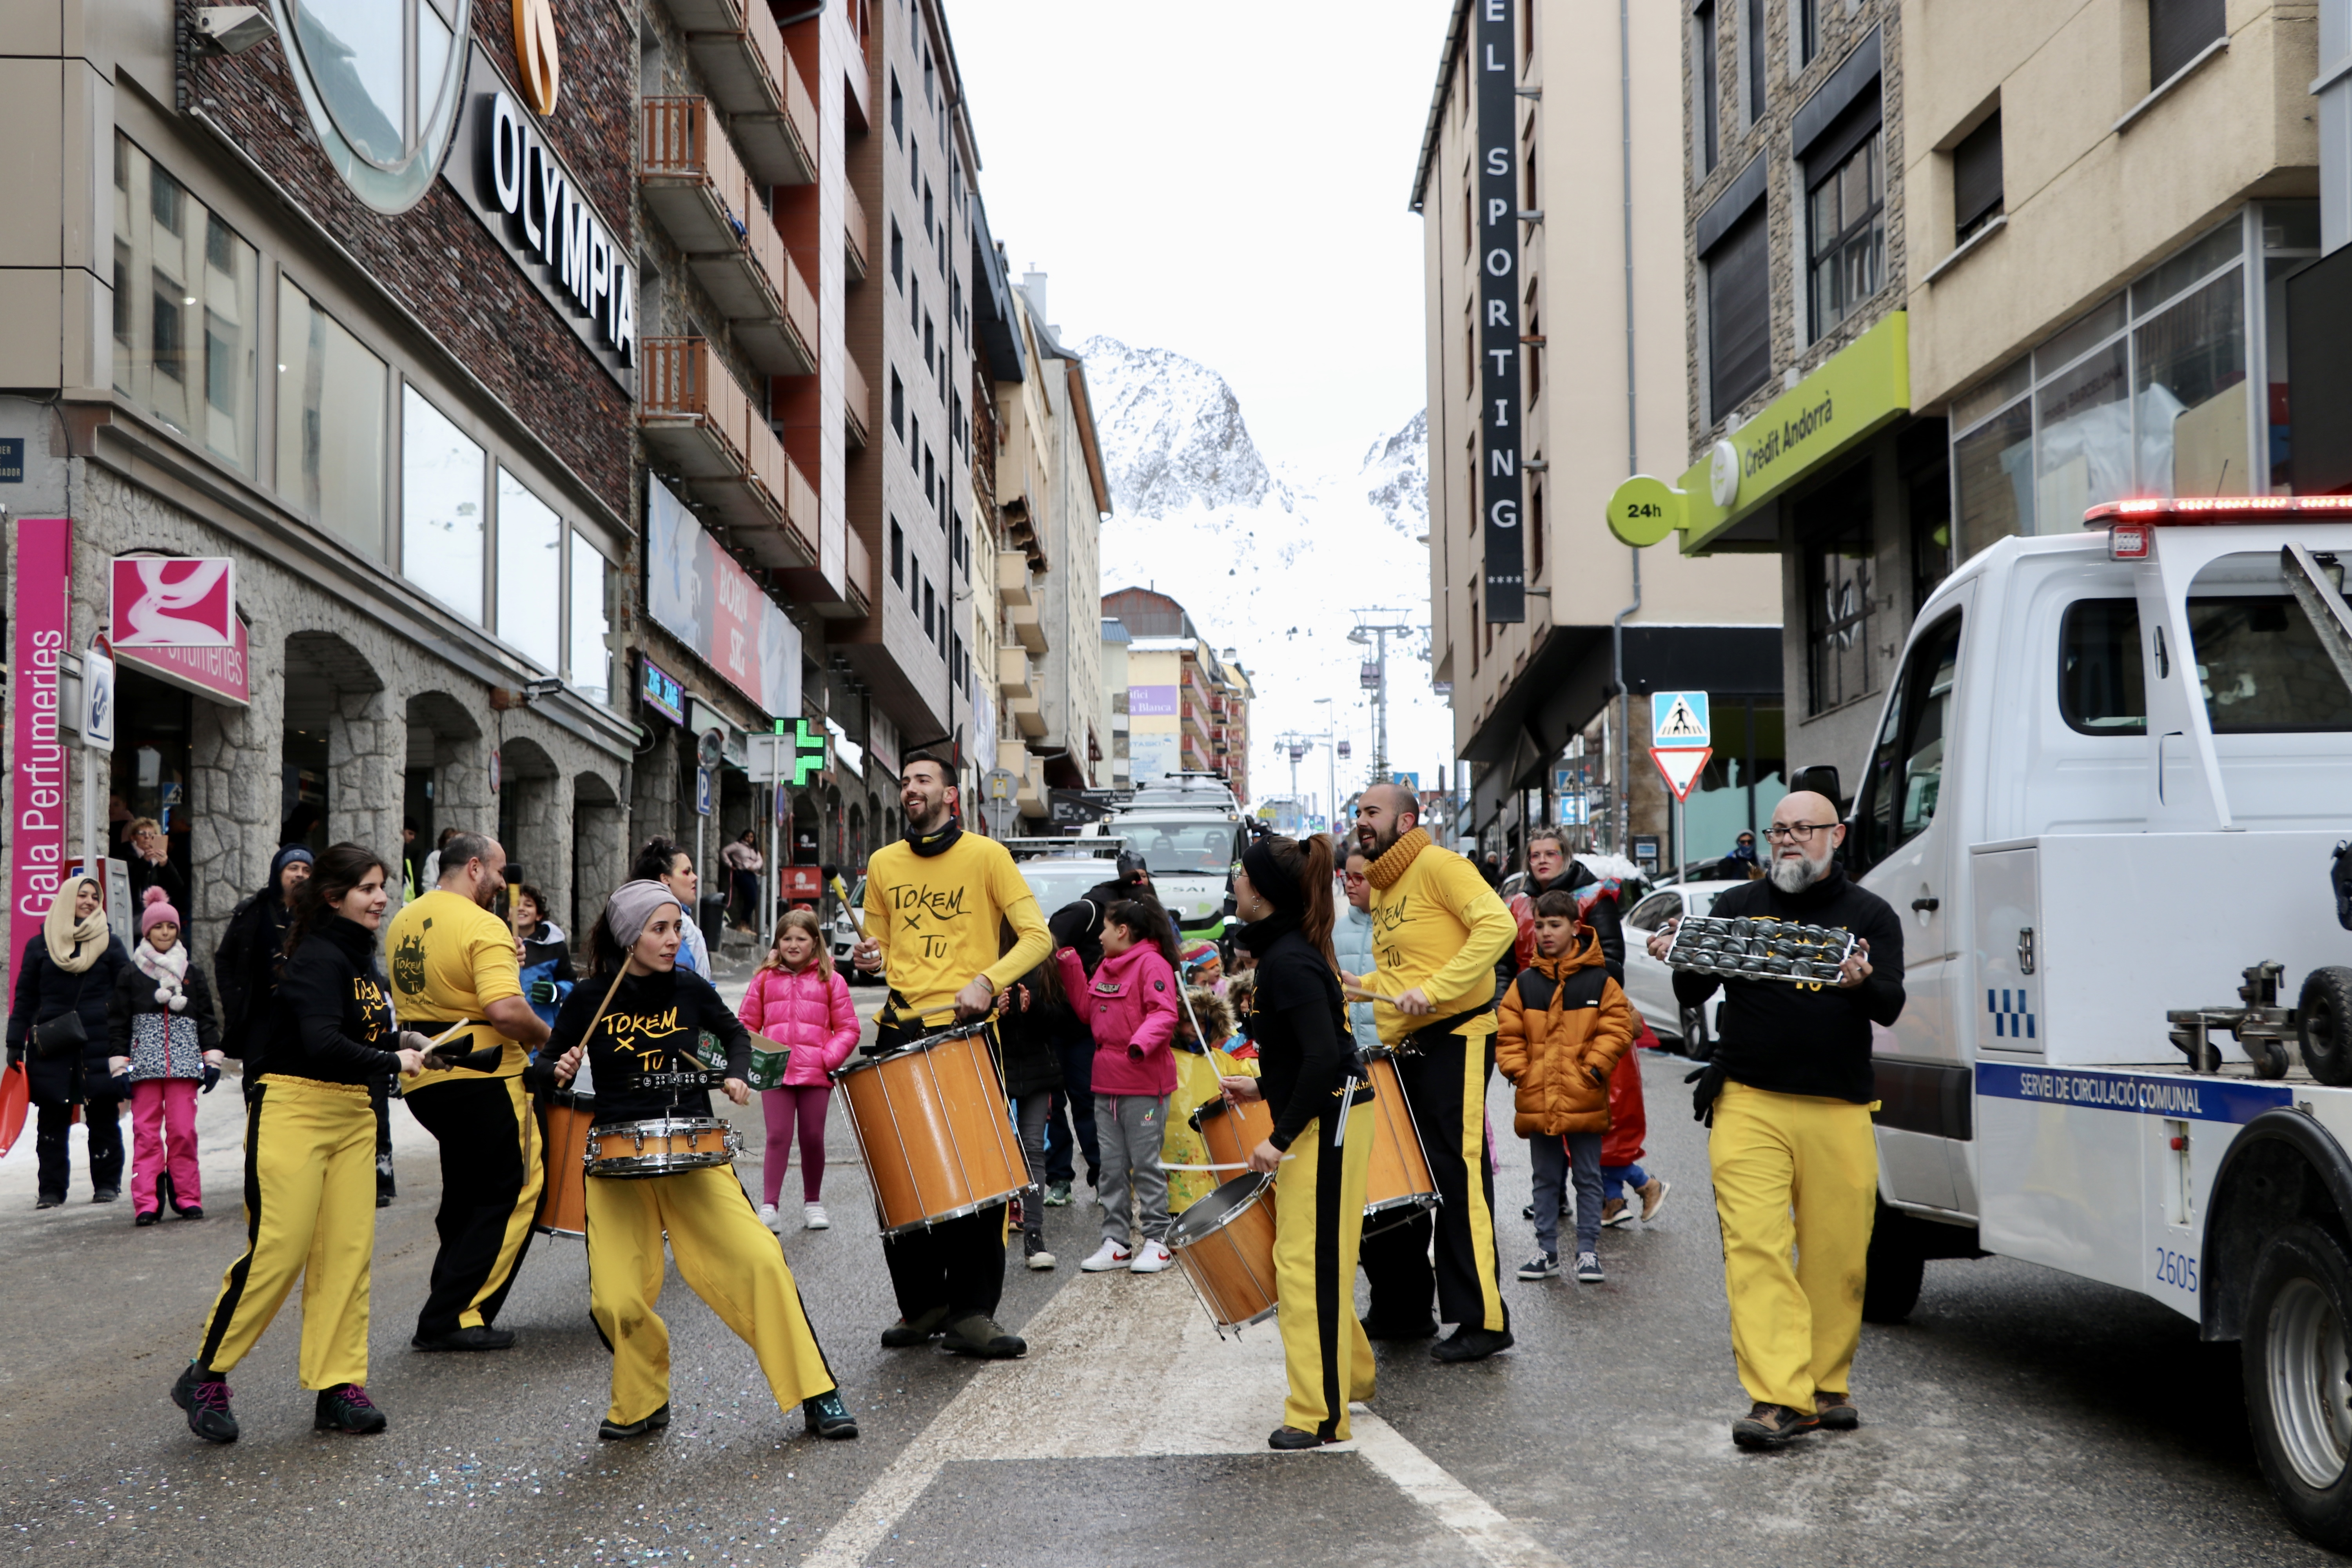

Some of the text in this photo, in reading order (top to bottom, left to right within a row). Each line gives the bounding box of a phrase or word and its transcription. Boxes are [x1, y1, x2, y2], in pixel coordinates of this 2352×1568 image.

[488, 91, 635, 368] OLYMPIA
[1486, 147, 1517, 528] SPORTING
[1745, 390, 1833, 479] Crèdit Andorrà
[1628, 504, 1662, 518] 24h
[719, 562, 748, 623] BORN
[1139, 703, 1171, 712] Blanca
[20, 630, 63, 917] Gala Perfumeries
[701, 773, 708, 807] P
[889, 884, 972, 920] TOKEM
[601, 1006, 689, 1038] TOKEM
[2020, 1073, 2203, 1113] SERVEI DE CIRCULACIÓ COMUNAL
[2156, 1247, 2197, 1292] 2605
